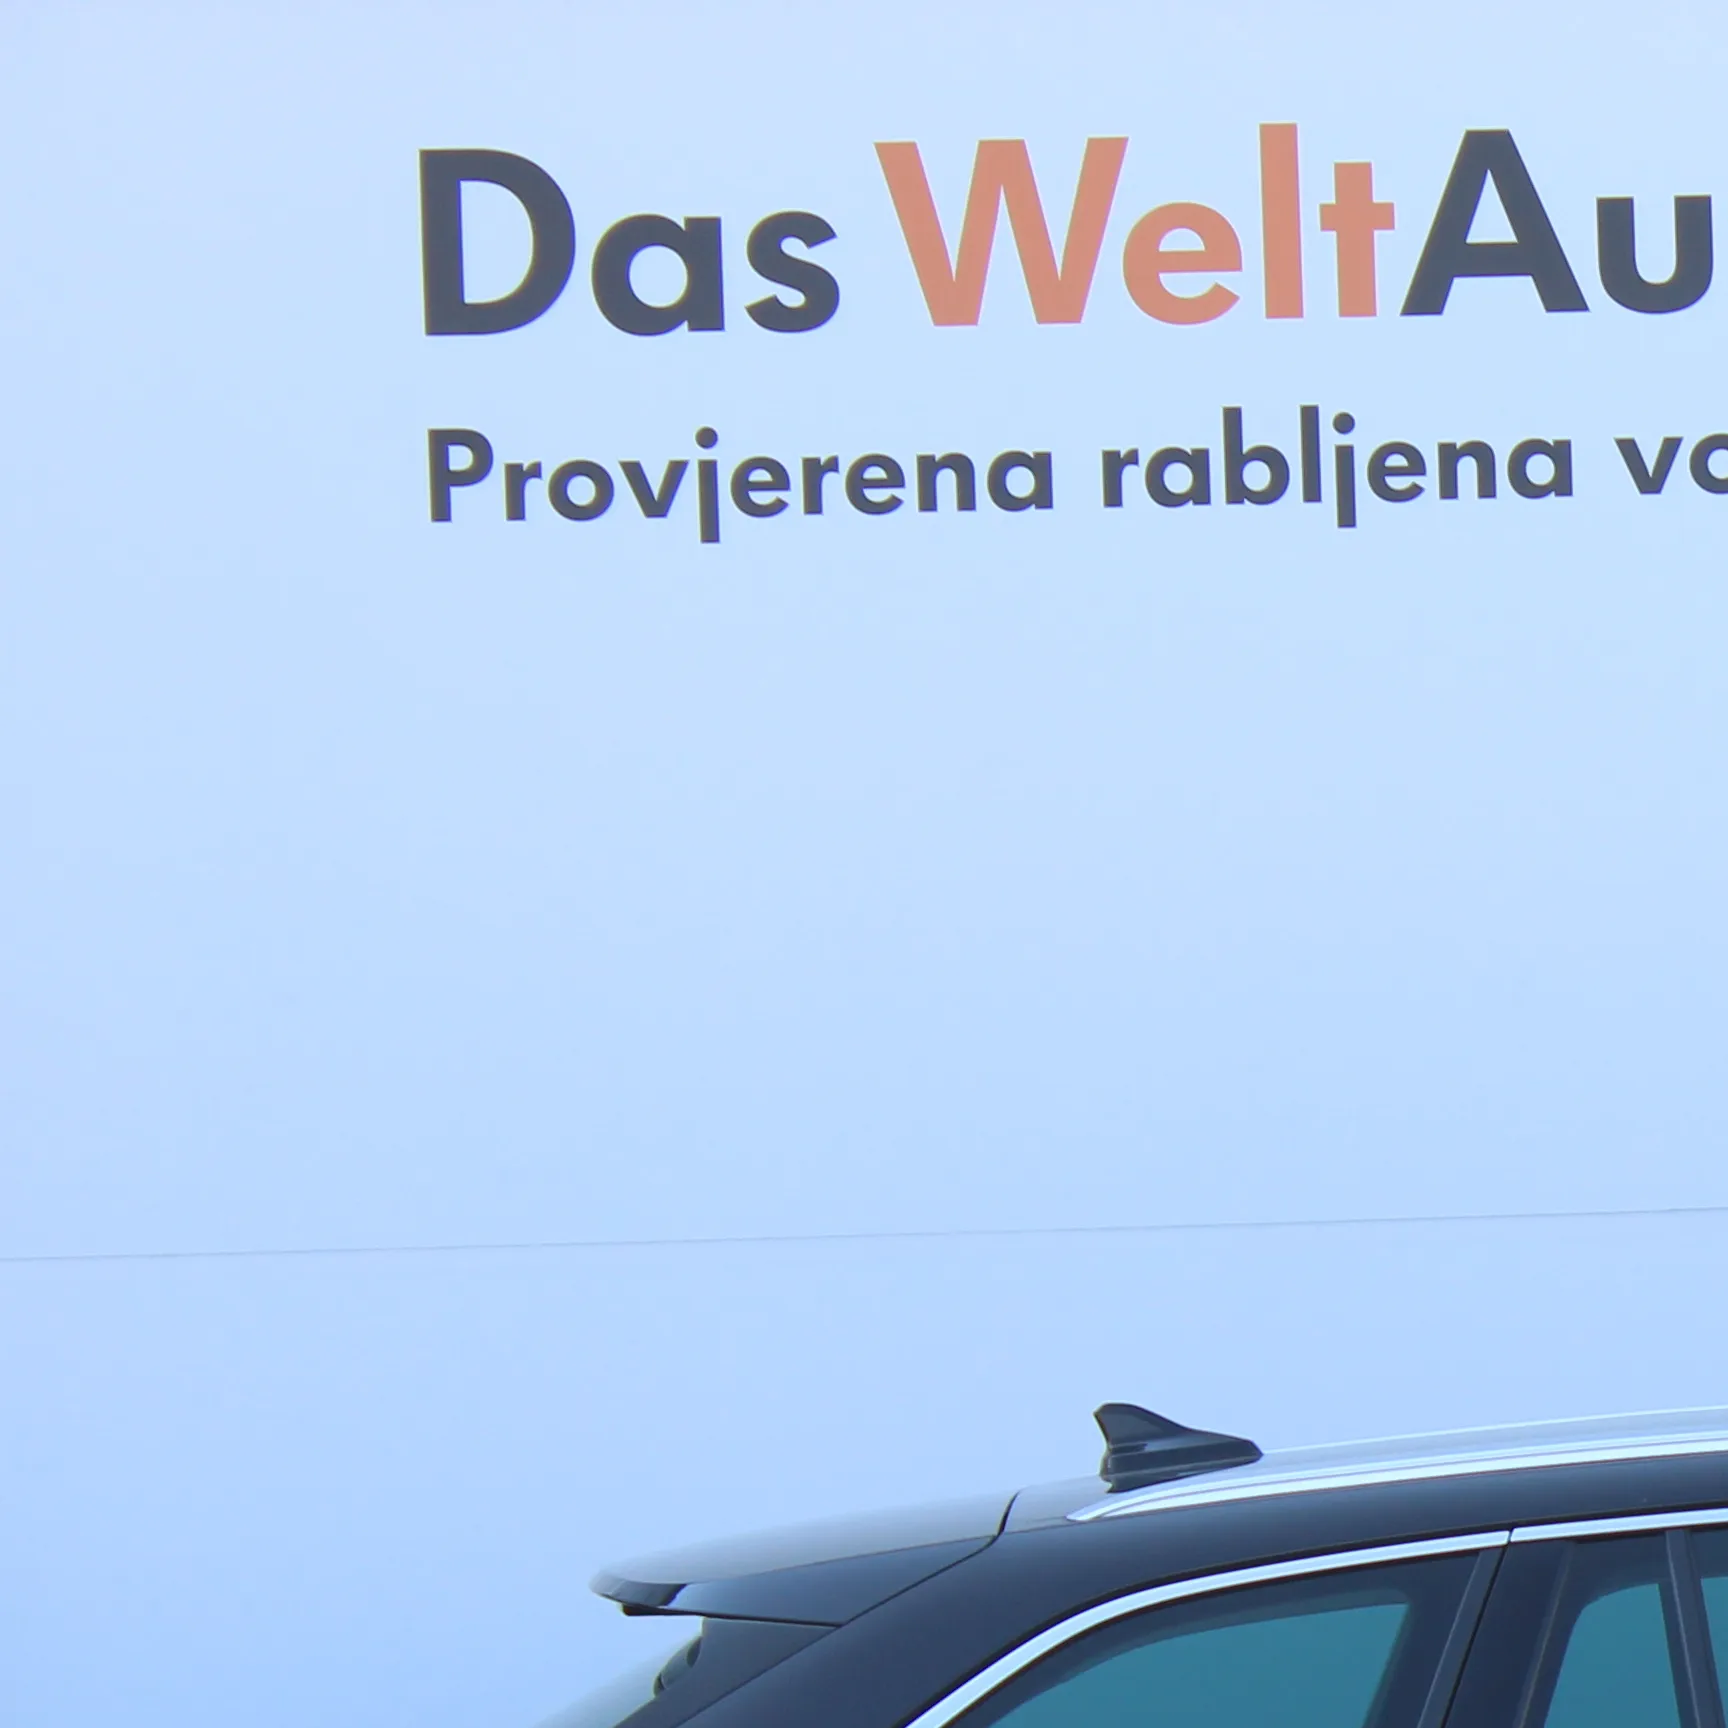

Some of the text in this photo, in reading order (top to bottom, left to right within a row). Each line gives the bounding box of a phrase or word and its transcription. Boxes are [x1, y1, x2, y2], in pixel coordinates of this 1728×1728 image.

[420, 149, 841, 337] Das
[427, 426, 1054, 544] Provjerena
[1101, 404, 1574, 529] rabljena
